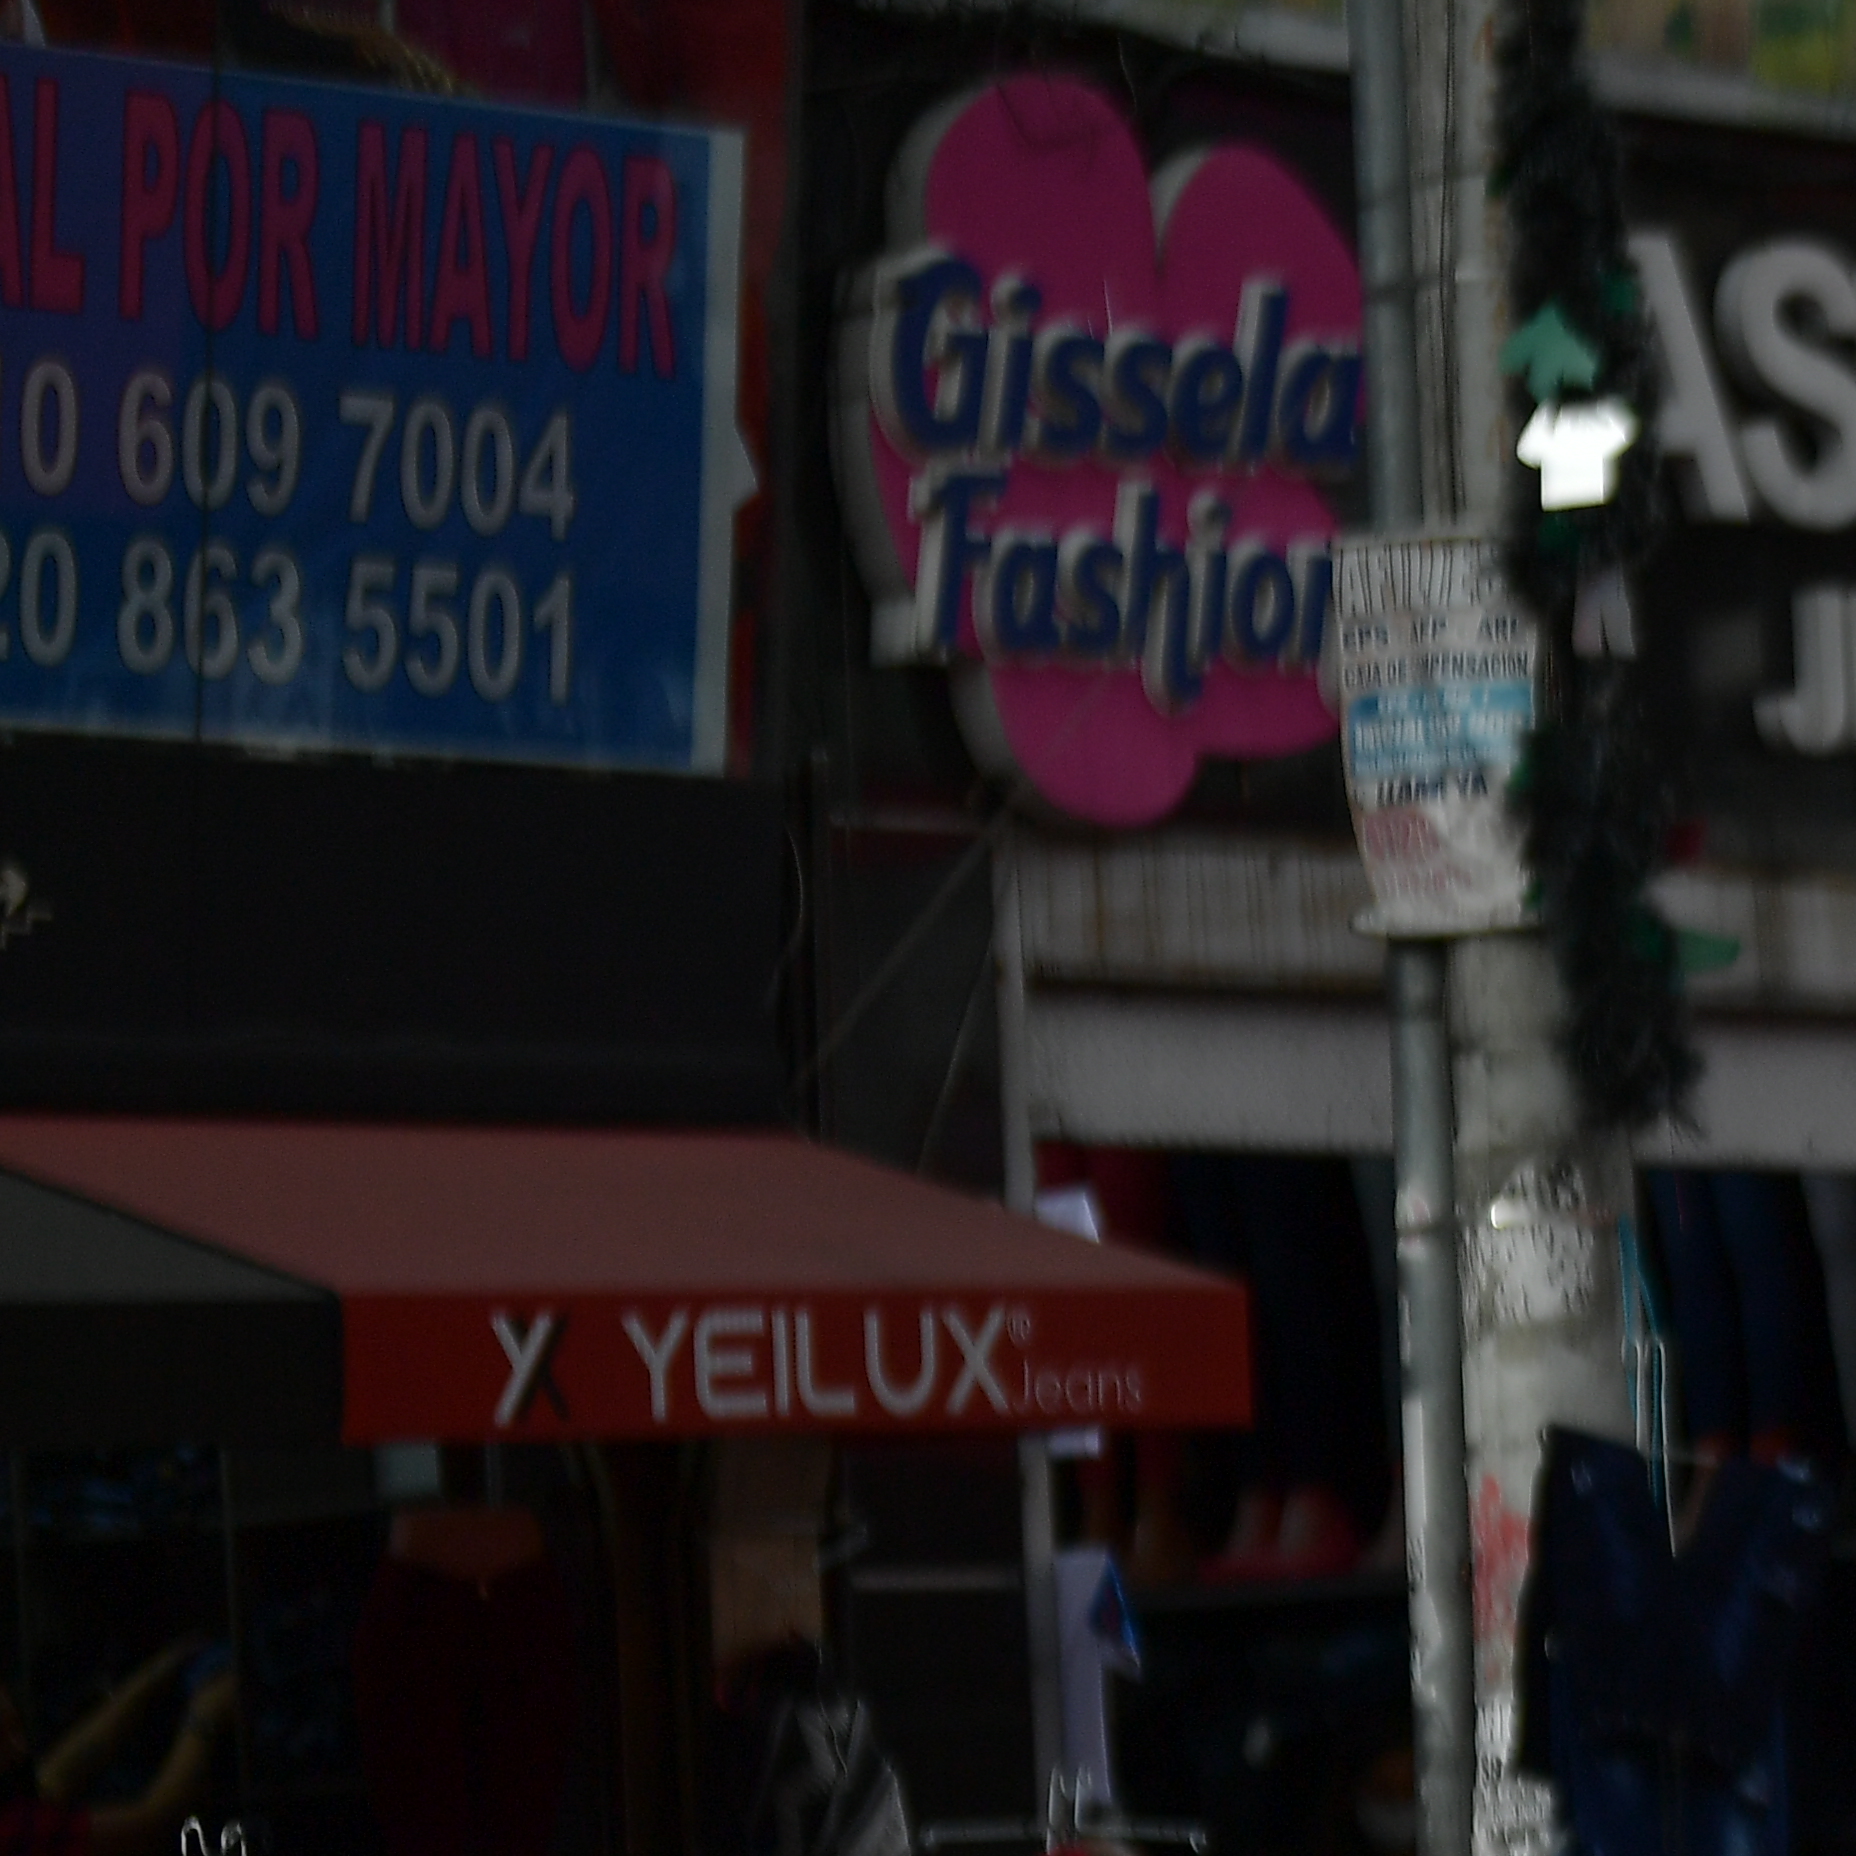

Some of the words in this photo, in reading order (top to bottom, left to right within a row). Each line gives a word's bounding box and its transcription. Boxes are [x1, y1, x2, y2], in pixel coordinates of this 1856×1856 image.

[118, 88, 320, 340] POR
[352, 120, 678, 380] MAYOR
[875, 252, 1362, 468] Gissela
[118, 372, 302, 516] 609
[338, 392, 575, 540] 7004
[116, 536, 305, 686] 863
[342, 555, 572, 704] 5501
[620, 1306, 1012, 1428] YEILUX
[1008, 1356, 1144, 1416] Jeans
